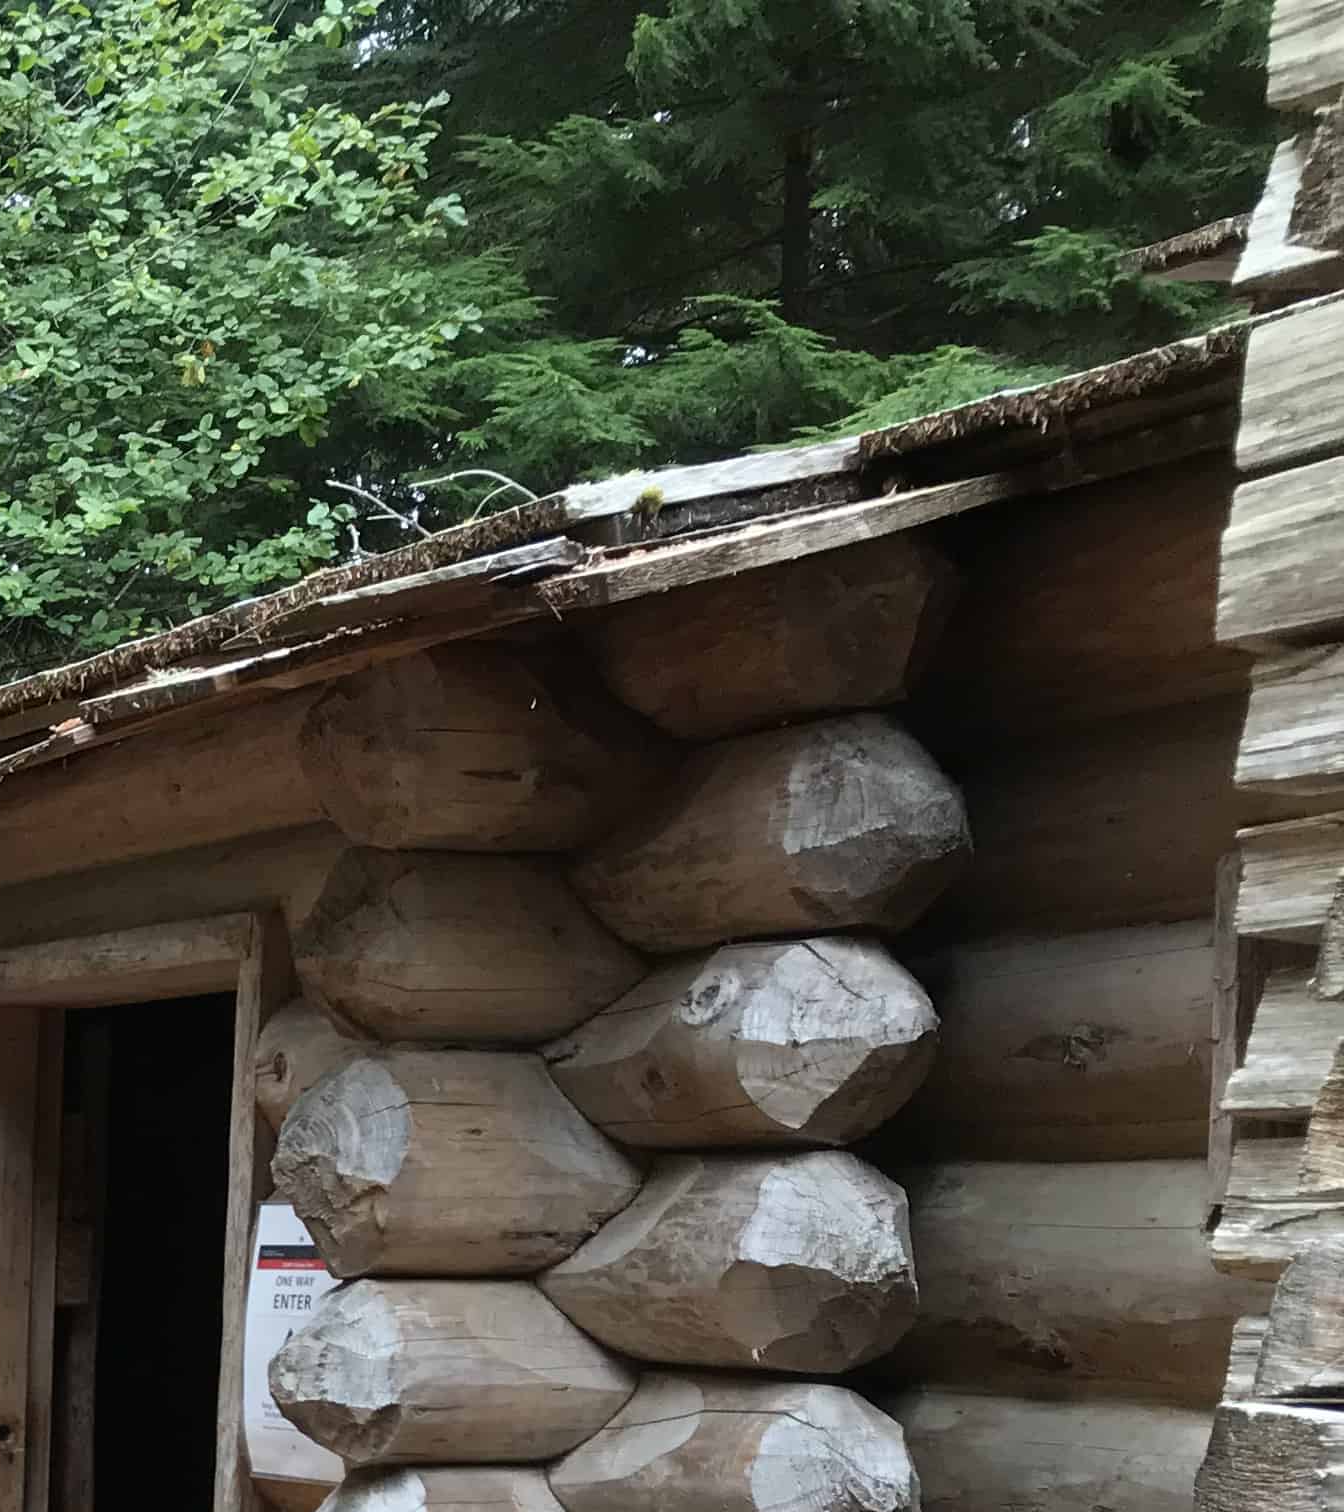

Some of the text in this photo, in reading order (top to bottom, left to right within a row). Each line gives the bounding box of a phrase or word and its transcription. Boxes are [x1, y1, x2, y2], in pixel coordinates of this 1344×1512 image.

[275, 1275, 315, 1288] ONE WAY
[273, 1293, 312, 1310] ENTER
